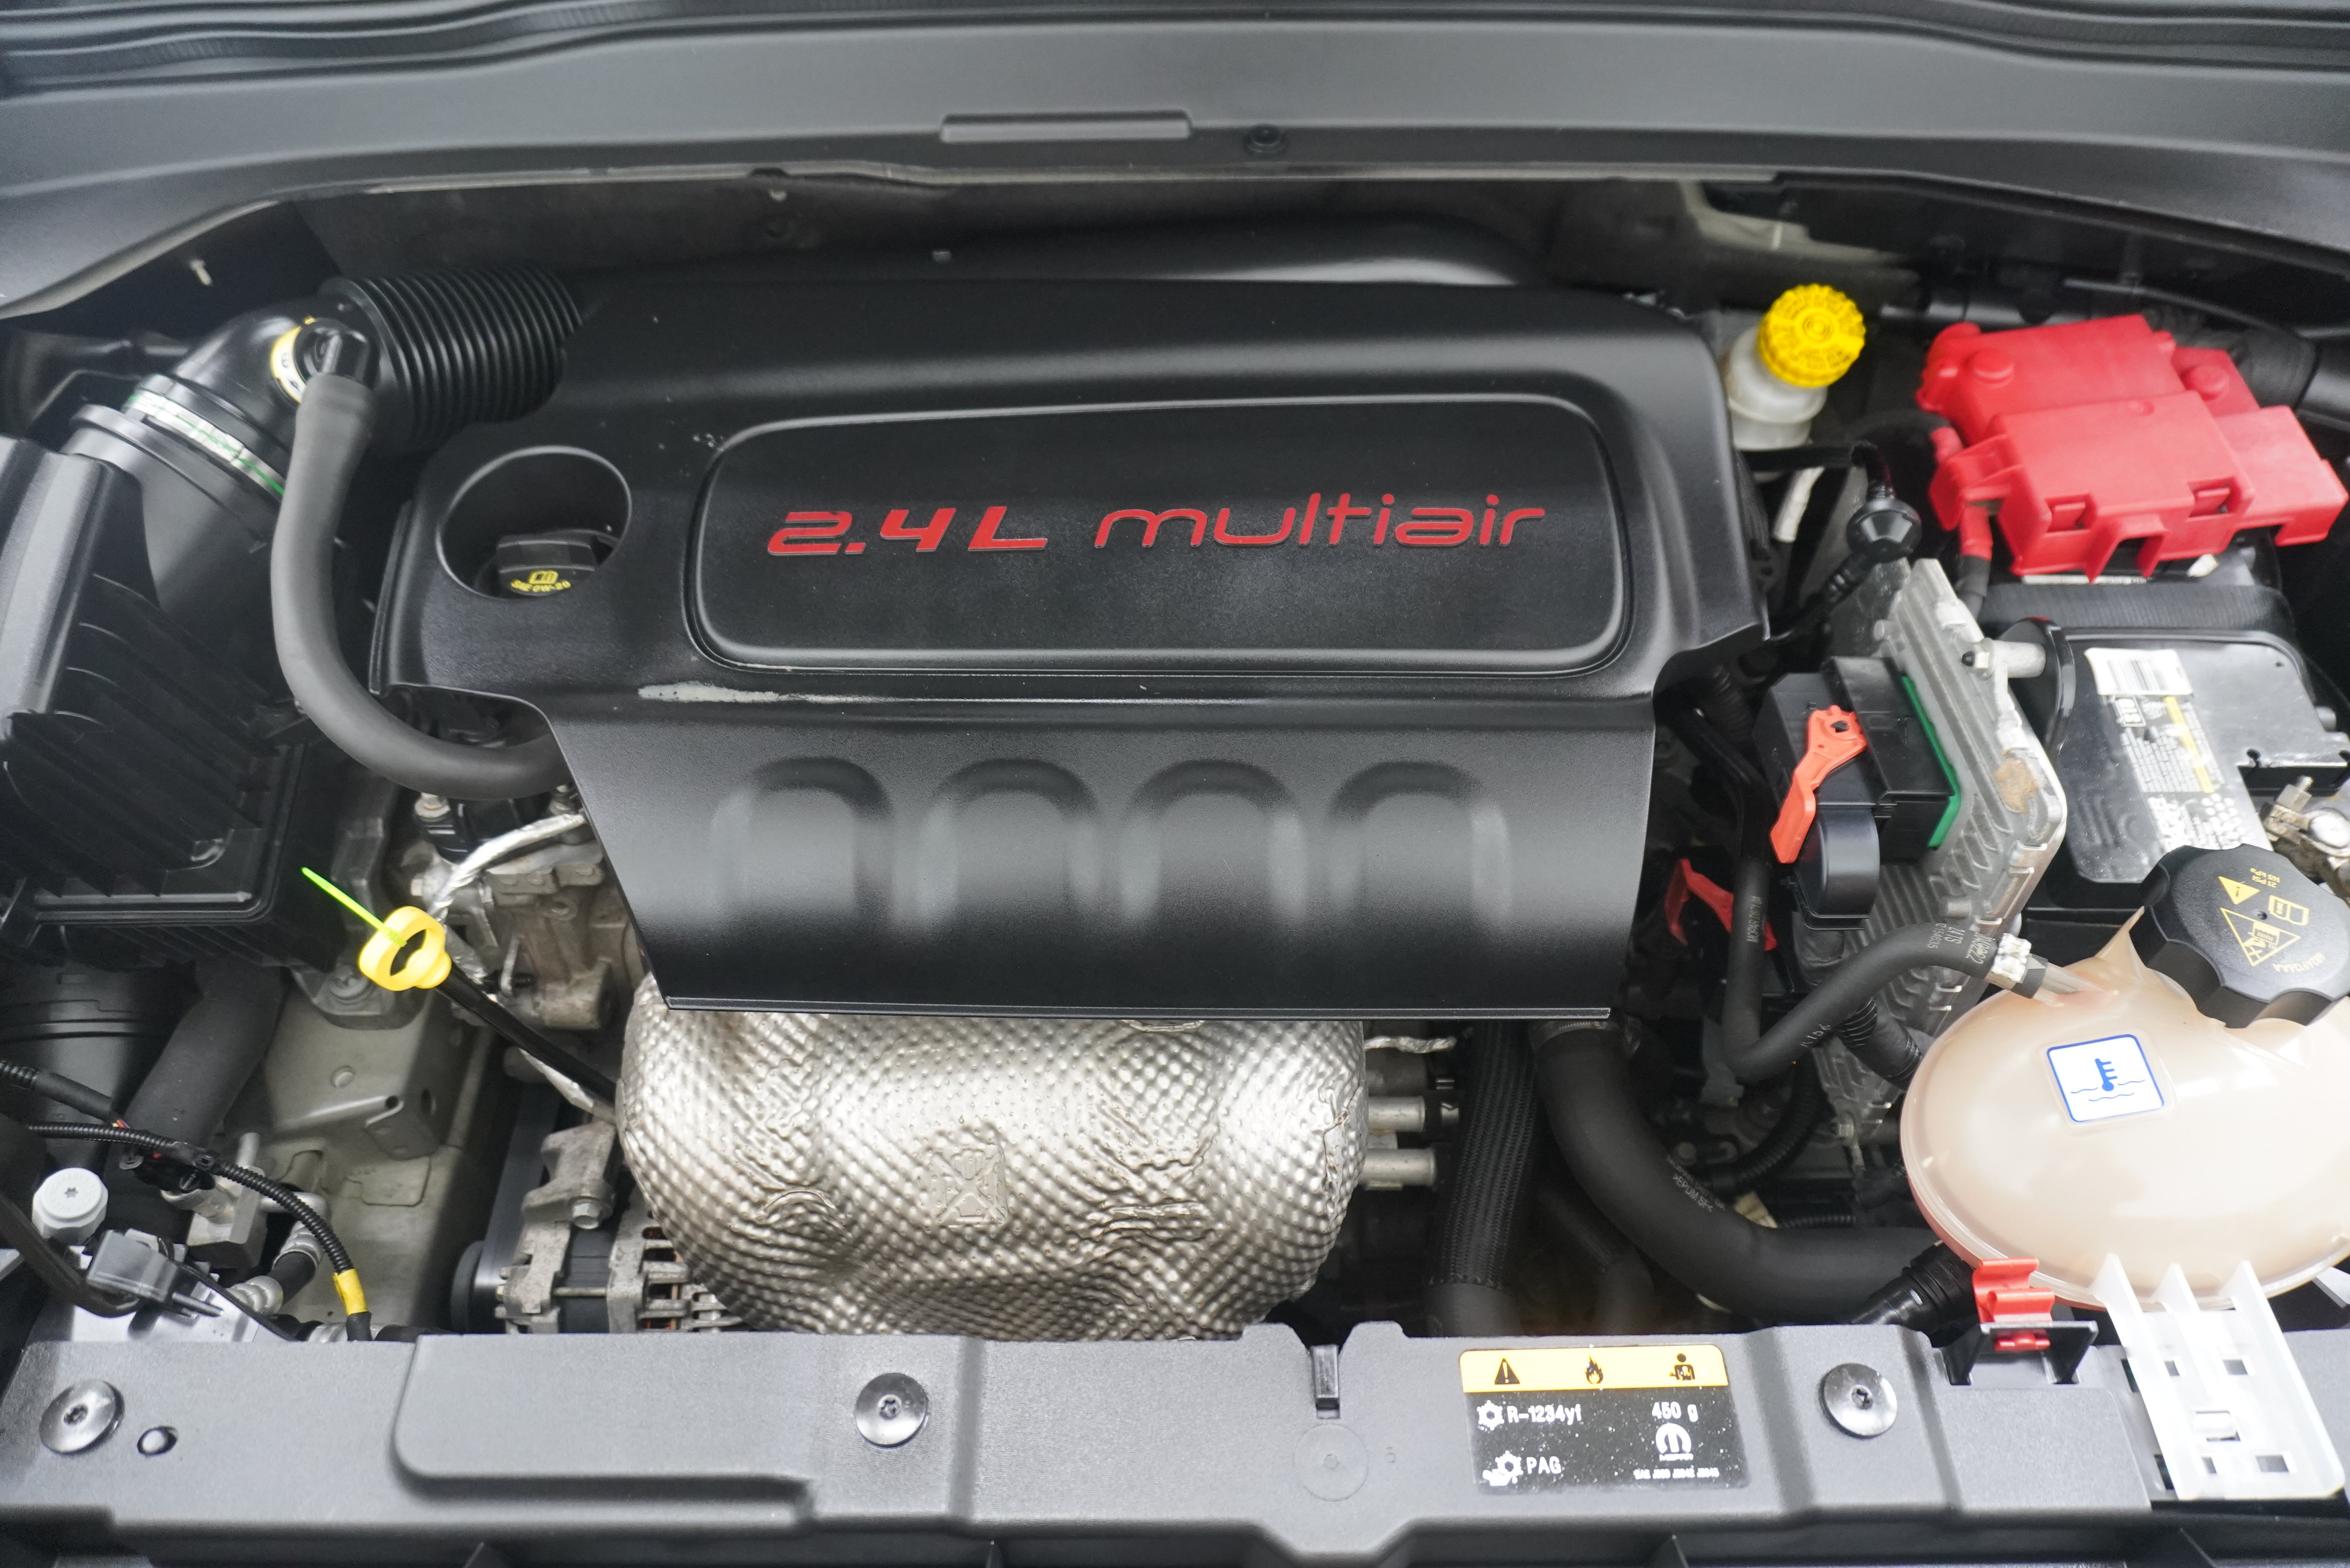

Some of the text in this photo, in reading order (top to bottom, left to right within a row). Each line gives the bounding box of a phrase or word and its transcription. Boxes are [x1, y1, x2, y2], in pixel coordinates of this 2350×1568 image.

[1094, 492, 1546, 548] multiair
[2251, 874, 2267, 885] PSI
[1507, 1402, 1699, 1425] R-1234yf 450 g
[1526, 1456, 1562, 1474] PAG
